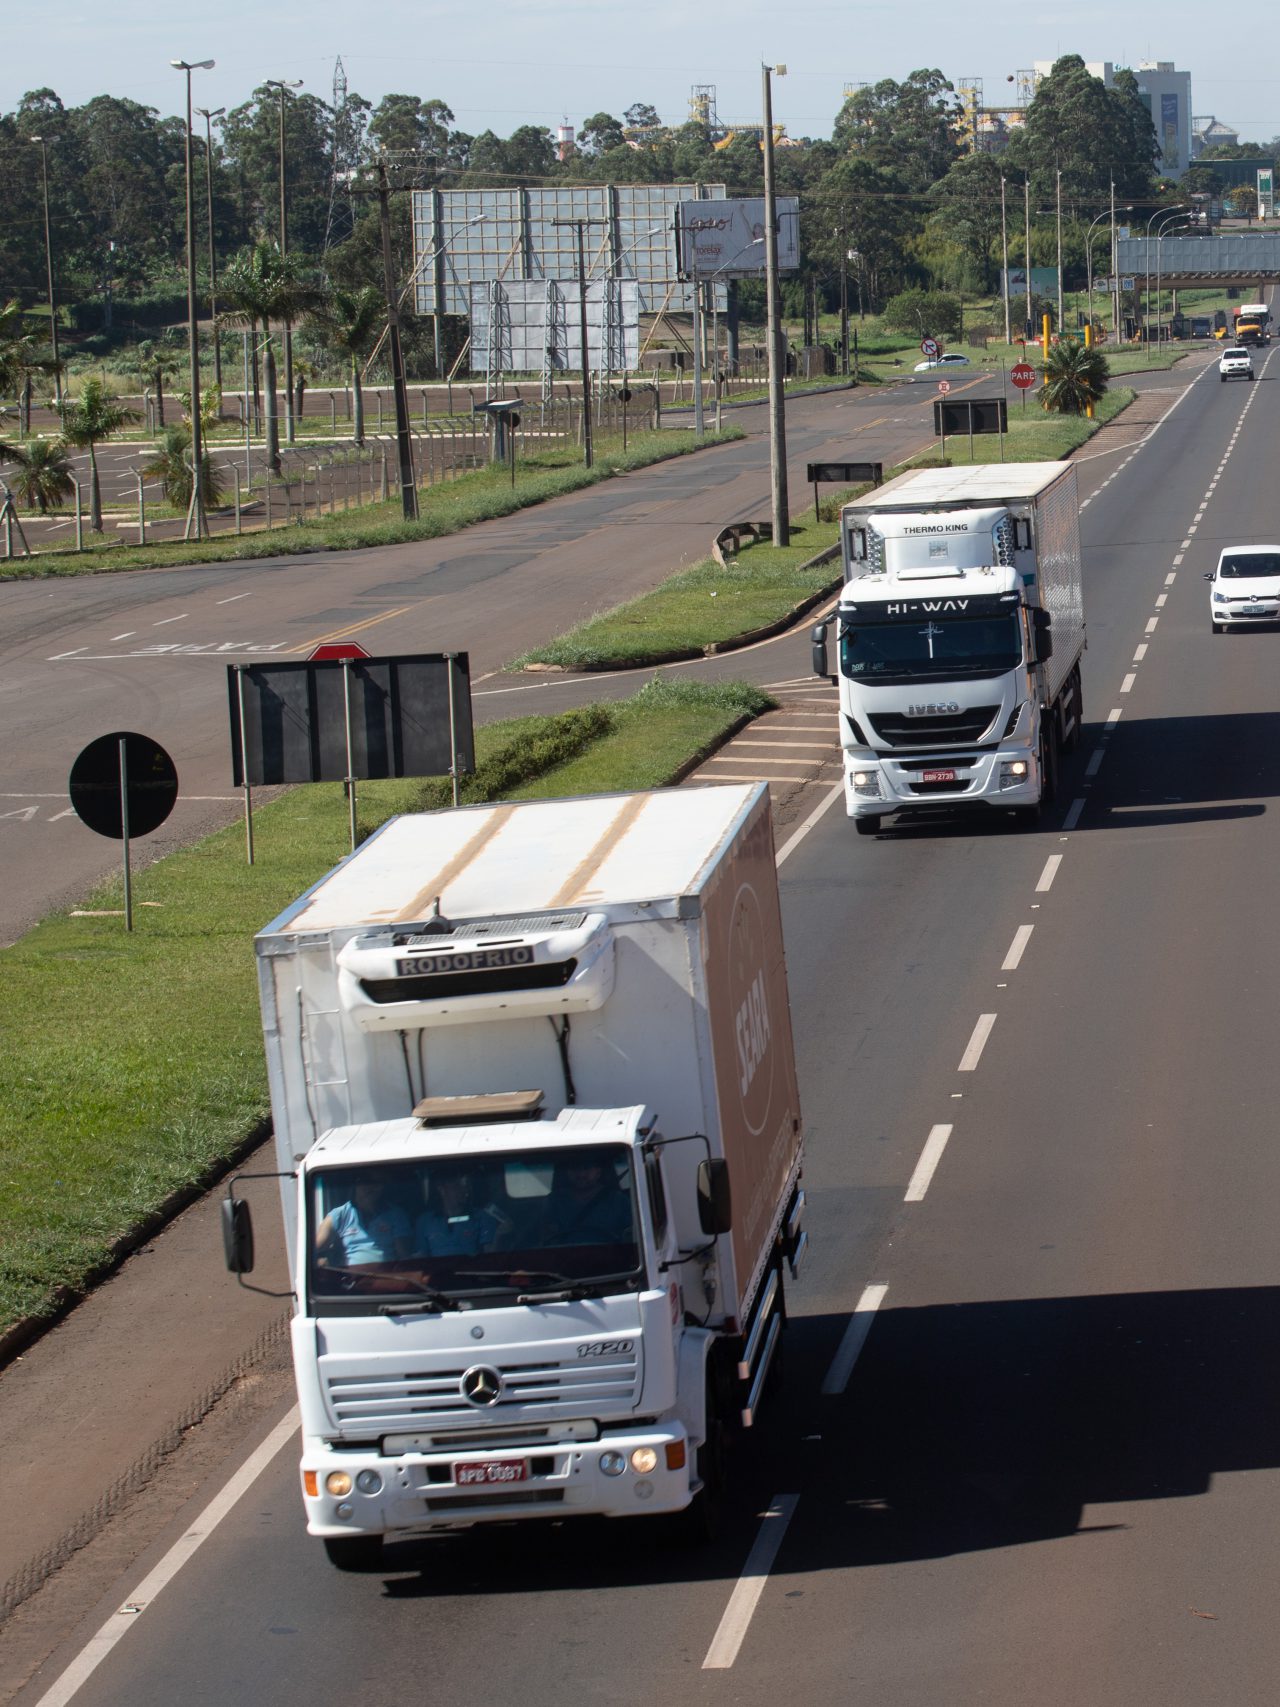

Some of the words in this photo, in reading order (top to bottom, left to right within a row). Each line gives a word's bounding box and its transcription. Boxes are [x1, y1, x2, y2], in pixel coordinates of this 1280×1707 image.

[1011, 371, 1035, 380] PARE
[903, 525, 944, 534] THERMO
[945, 523, 968, 532] KING
[887, 599, 969, 614] HI-WAY
[908, 701, 959, 716] IVECO
[401, 947, 529, 975] RODOFRIO
[735, 967, 771, 1097] SEARA
[576, 1339, 635, 1358] 1420
